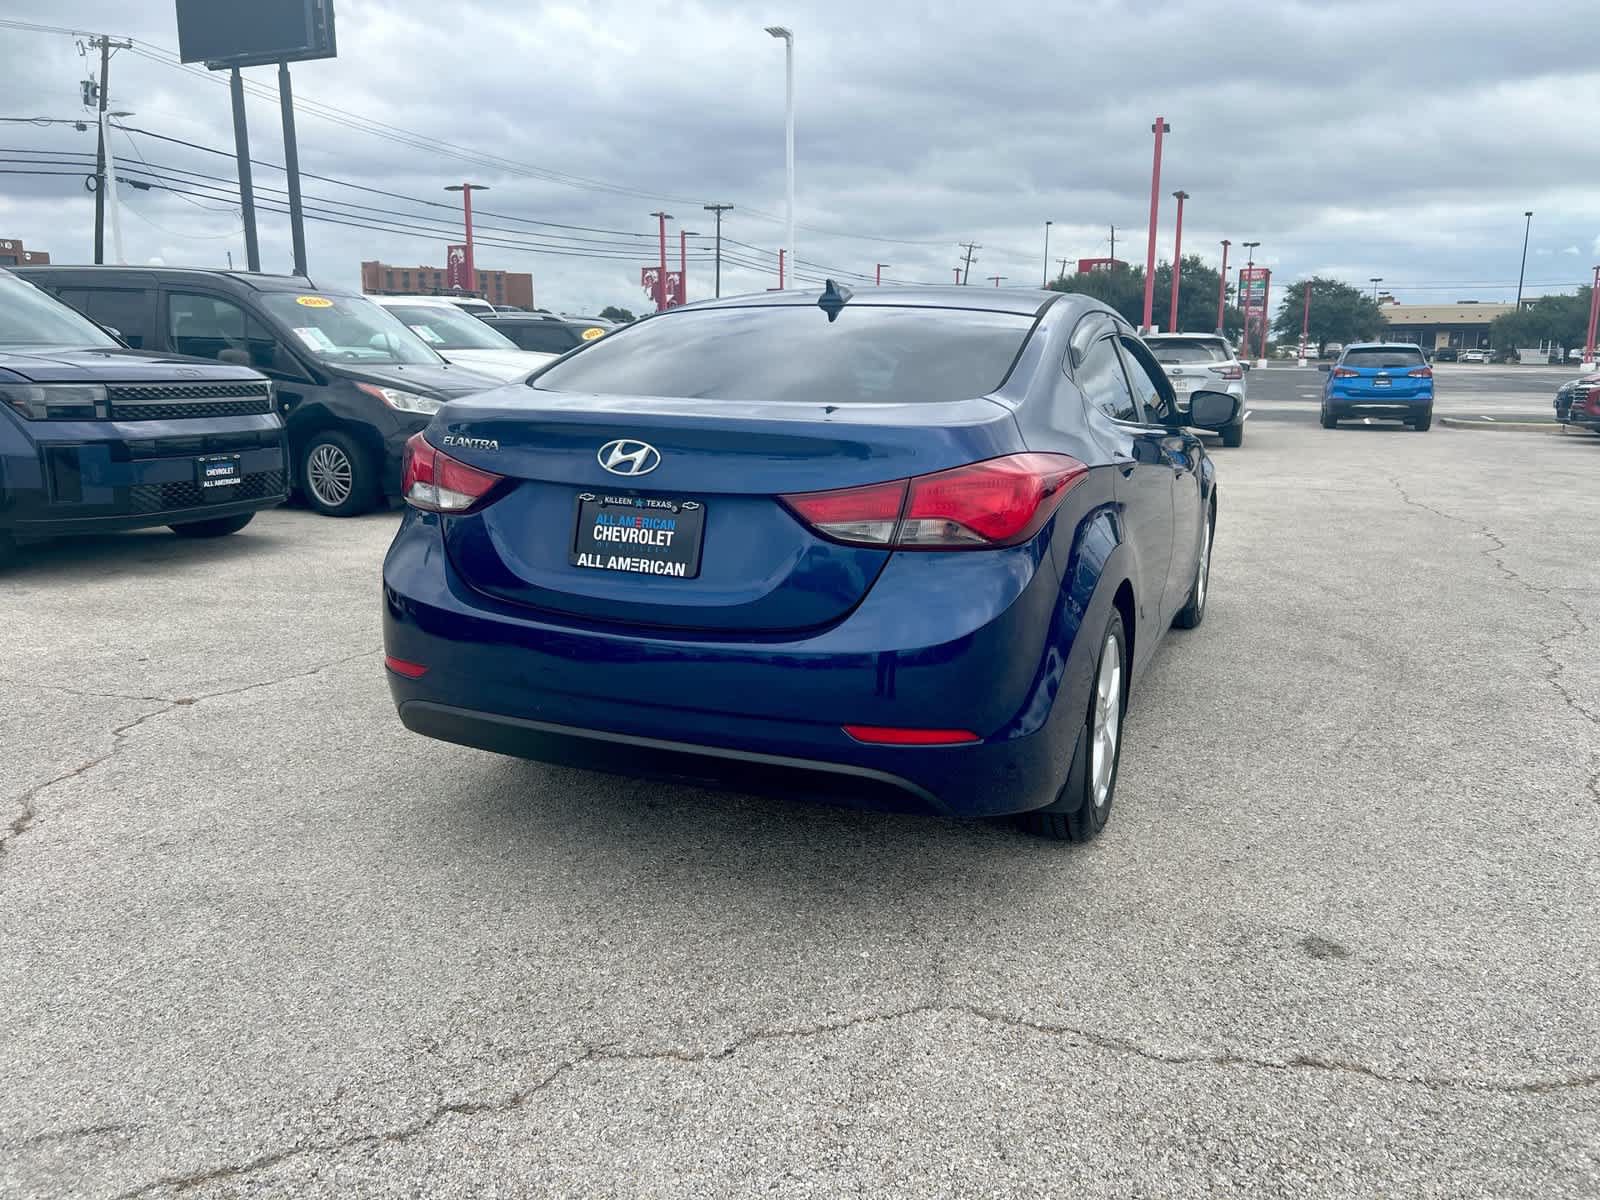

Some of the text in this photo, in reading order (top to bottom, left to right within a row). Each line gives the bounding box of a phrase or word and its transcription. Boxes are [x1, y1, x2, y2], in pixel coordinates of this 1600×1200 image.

[443, 436, 499, 450] ELANTRA
[206, 467, 233, 476] CHEVROLET
[204, 478, 240, 488] ALL AMERICAN
[604, 496, 672, 509] KILLEEN TEXAS
[595, 513, 676, 530] ALL AMERICAN
[593, 525, 675, 547] CHEVROLET
[577, 553, 686, 577] ALL AMERICAN
